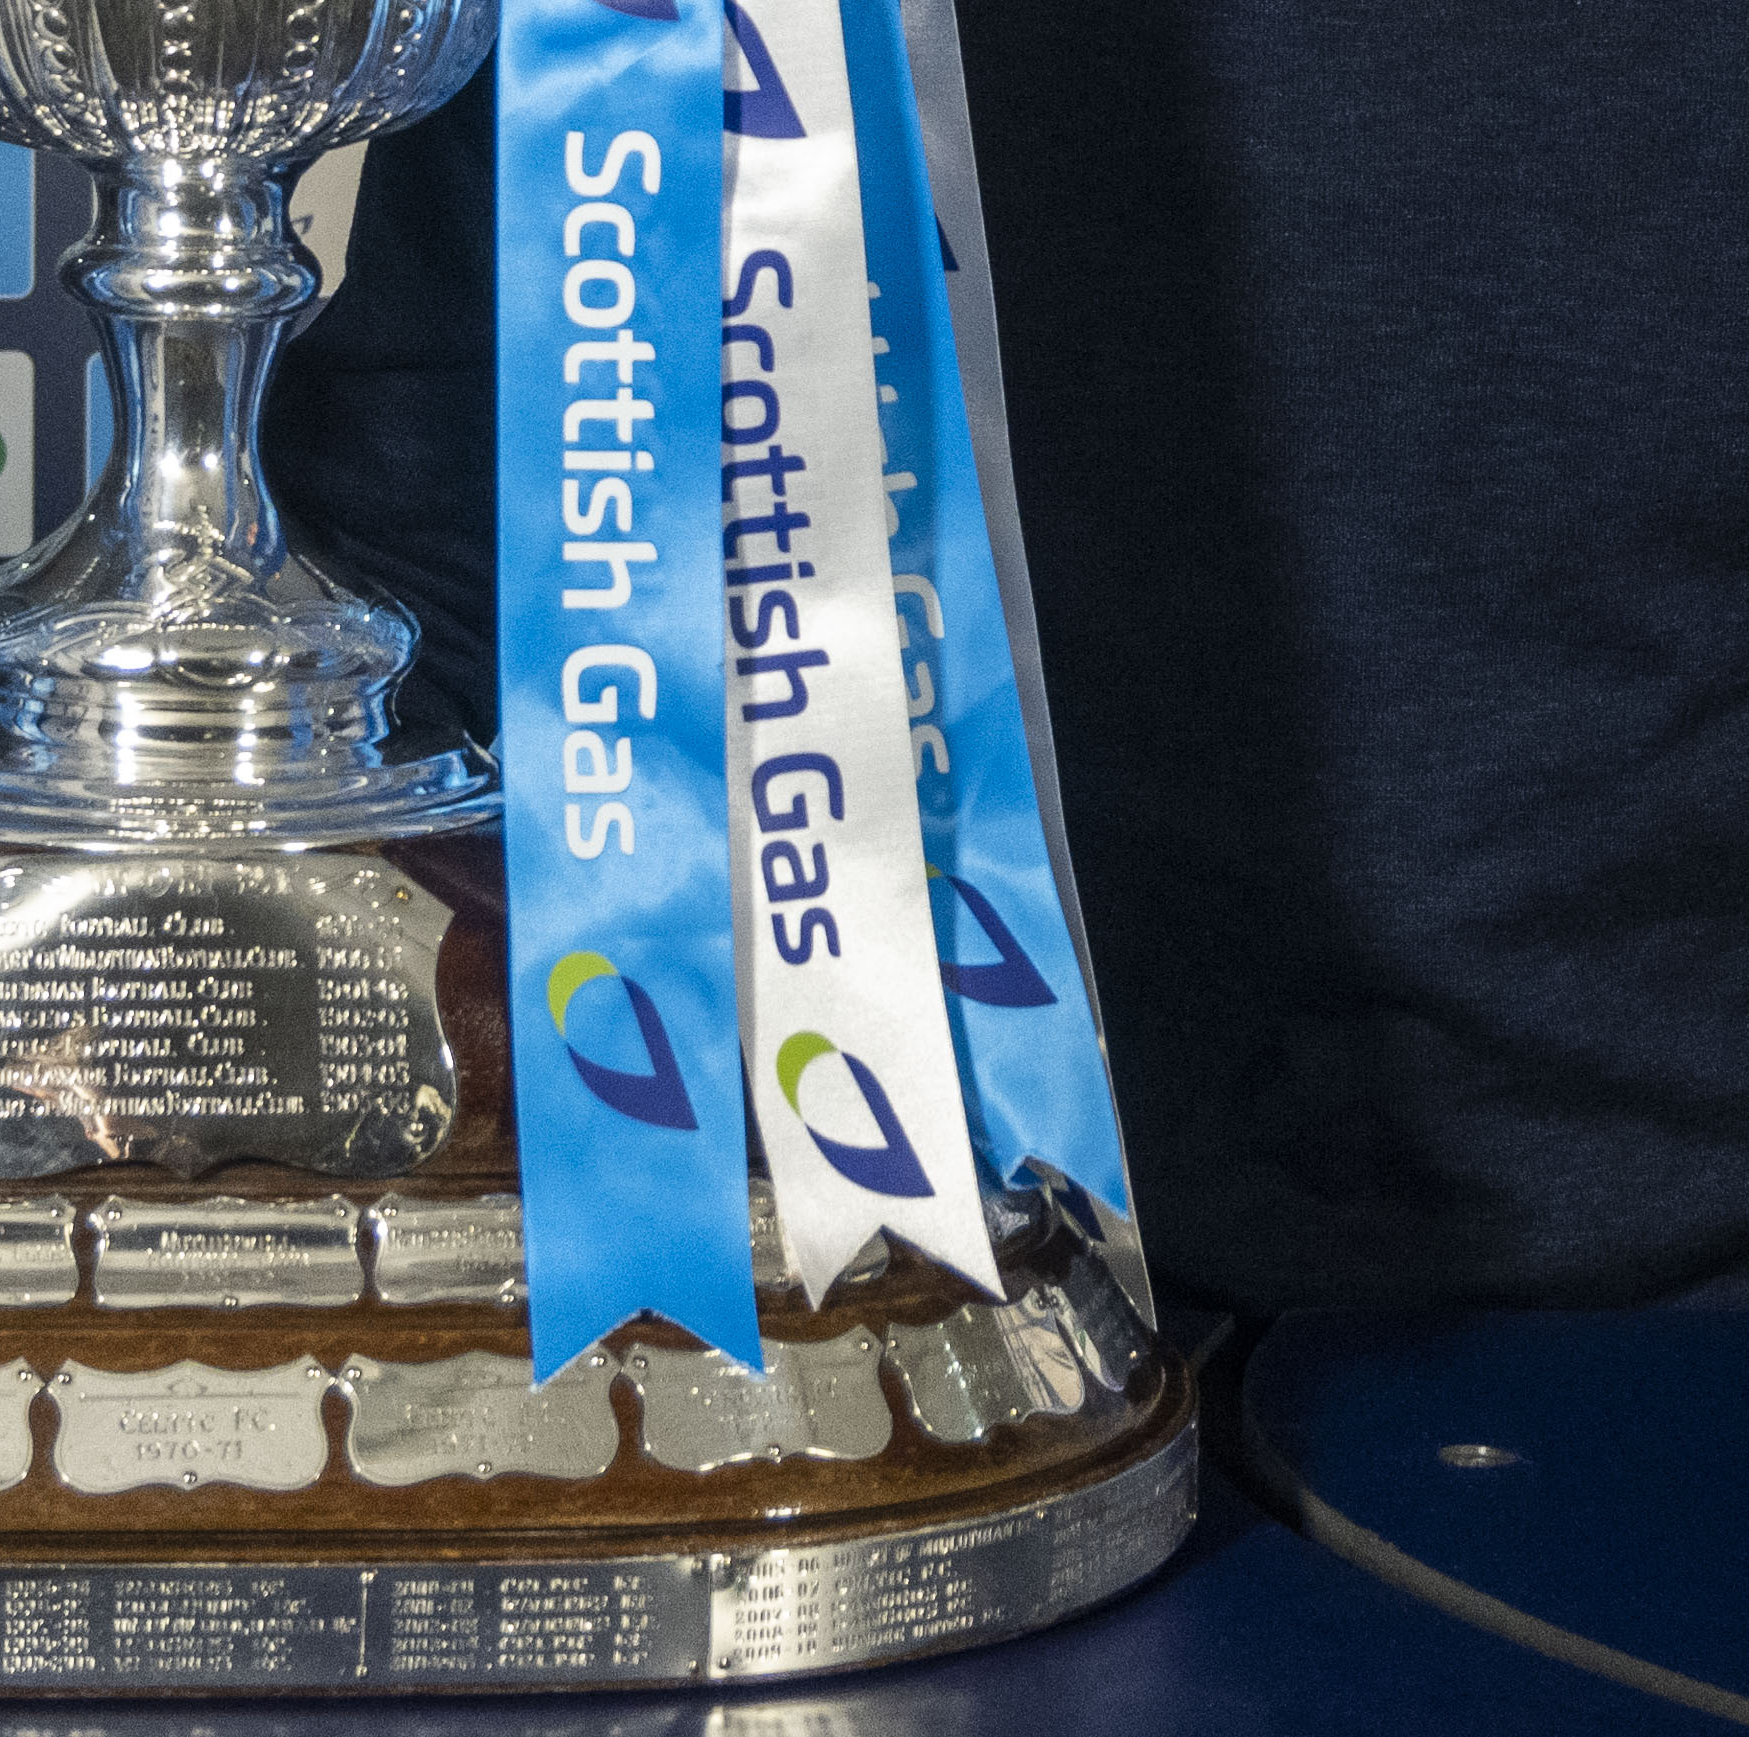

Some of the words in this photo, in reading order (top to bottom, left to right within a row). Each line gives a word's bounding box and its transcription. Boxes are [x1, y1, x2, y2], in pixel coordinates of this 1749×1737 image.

[562, 131, 661, 609] Scottish
[722, 248, 830, 722] Scottish
[562, 644, 656, 860] Gas
[752, 752, 844, 965] Gas
[119, 1409, 217, 1435] CELTIC
